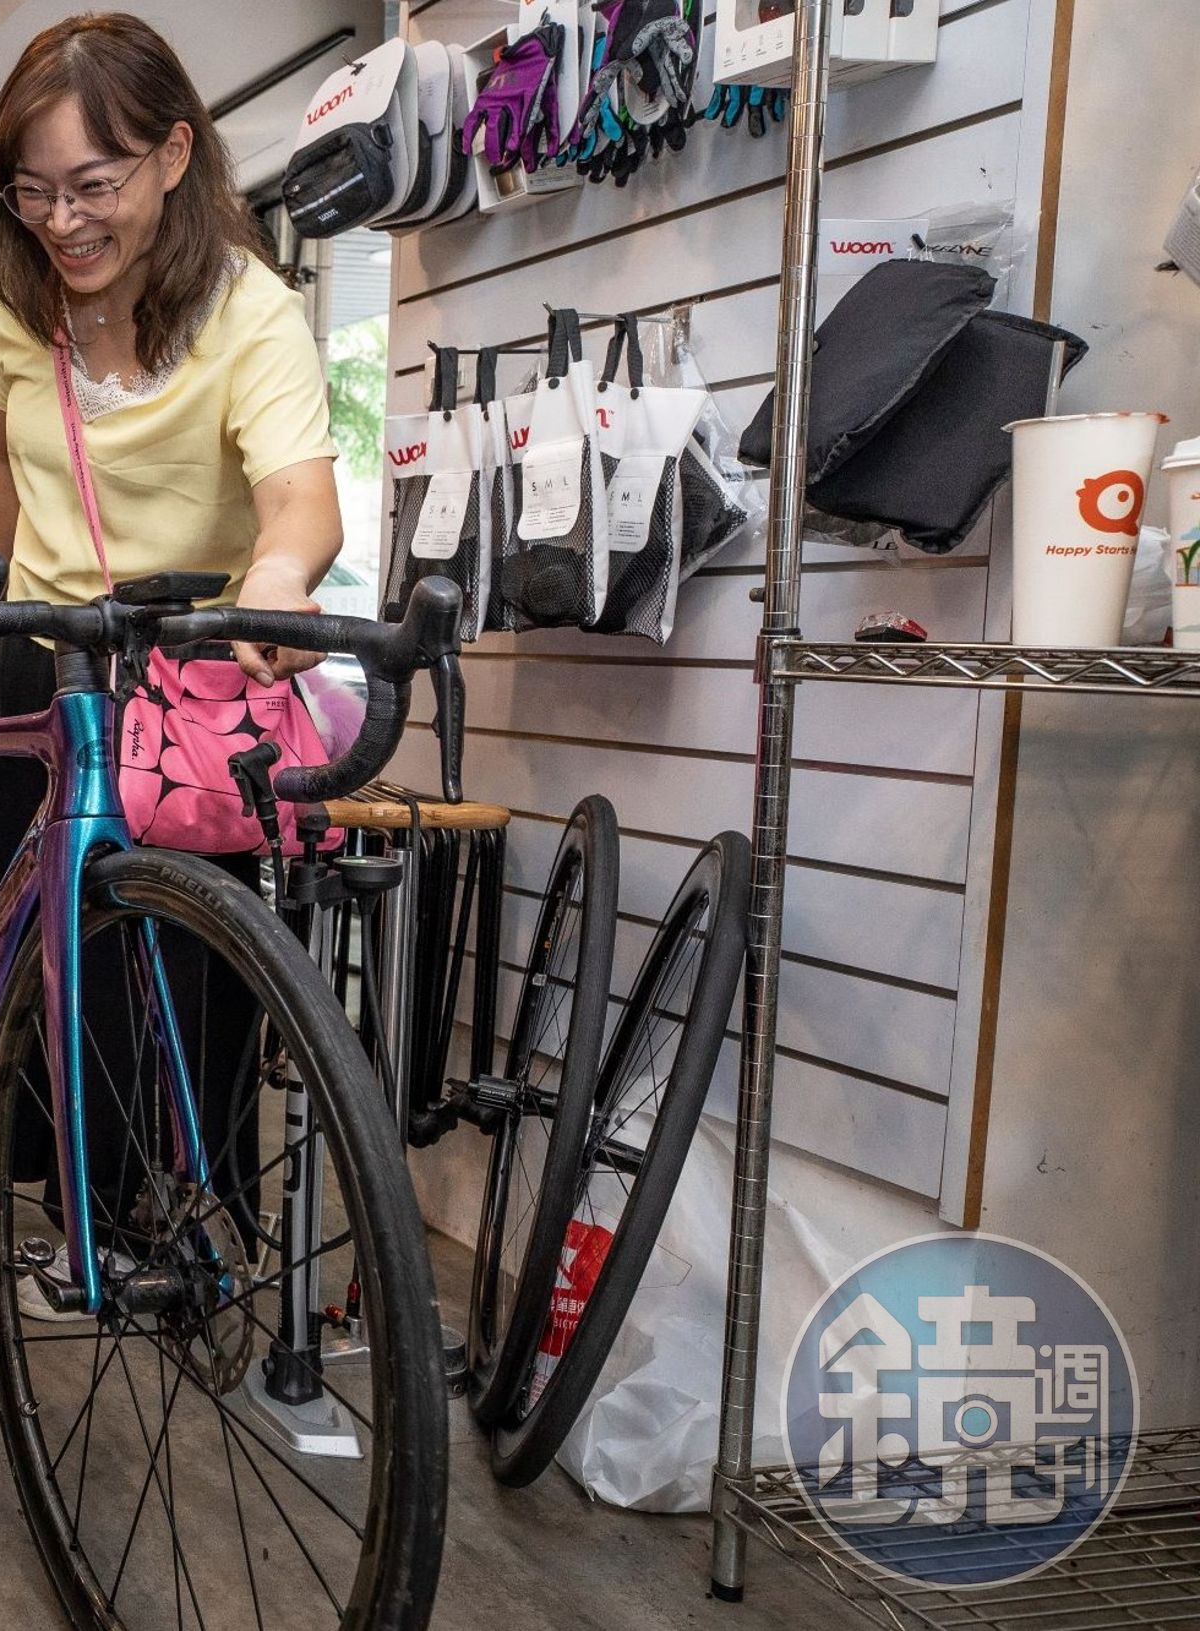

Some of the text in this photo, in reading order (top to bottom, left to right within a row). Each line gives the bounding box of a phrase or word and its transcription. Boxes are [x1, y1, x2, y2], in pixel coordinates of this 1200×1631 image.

[306, 85, 354, 126] woom
[830, 241, 894, 254] woom
[1046, 545, 1093, 556] Happy
[160, 866, 223, 910] PIRELLI
